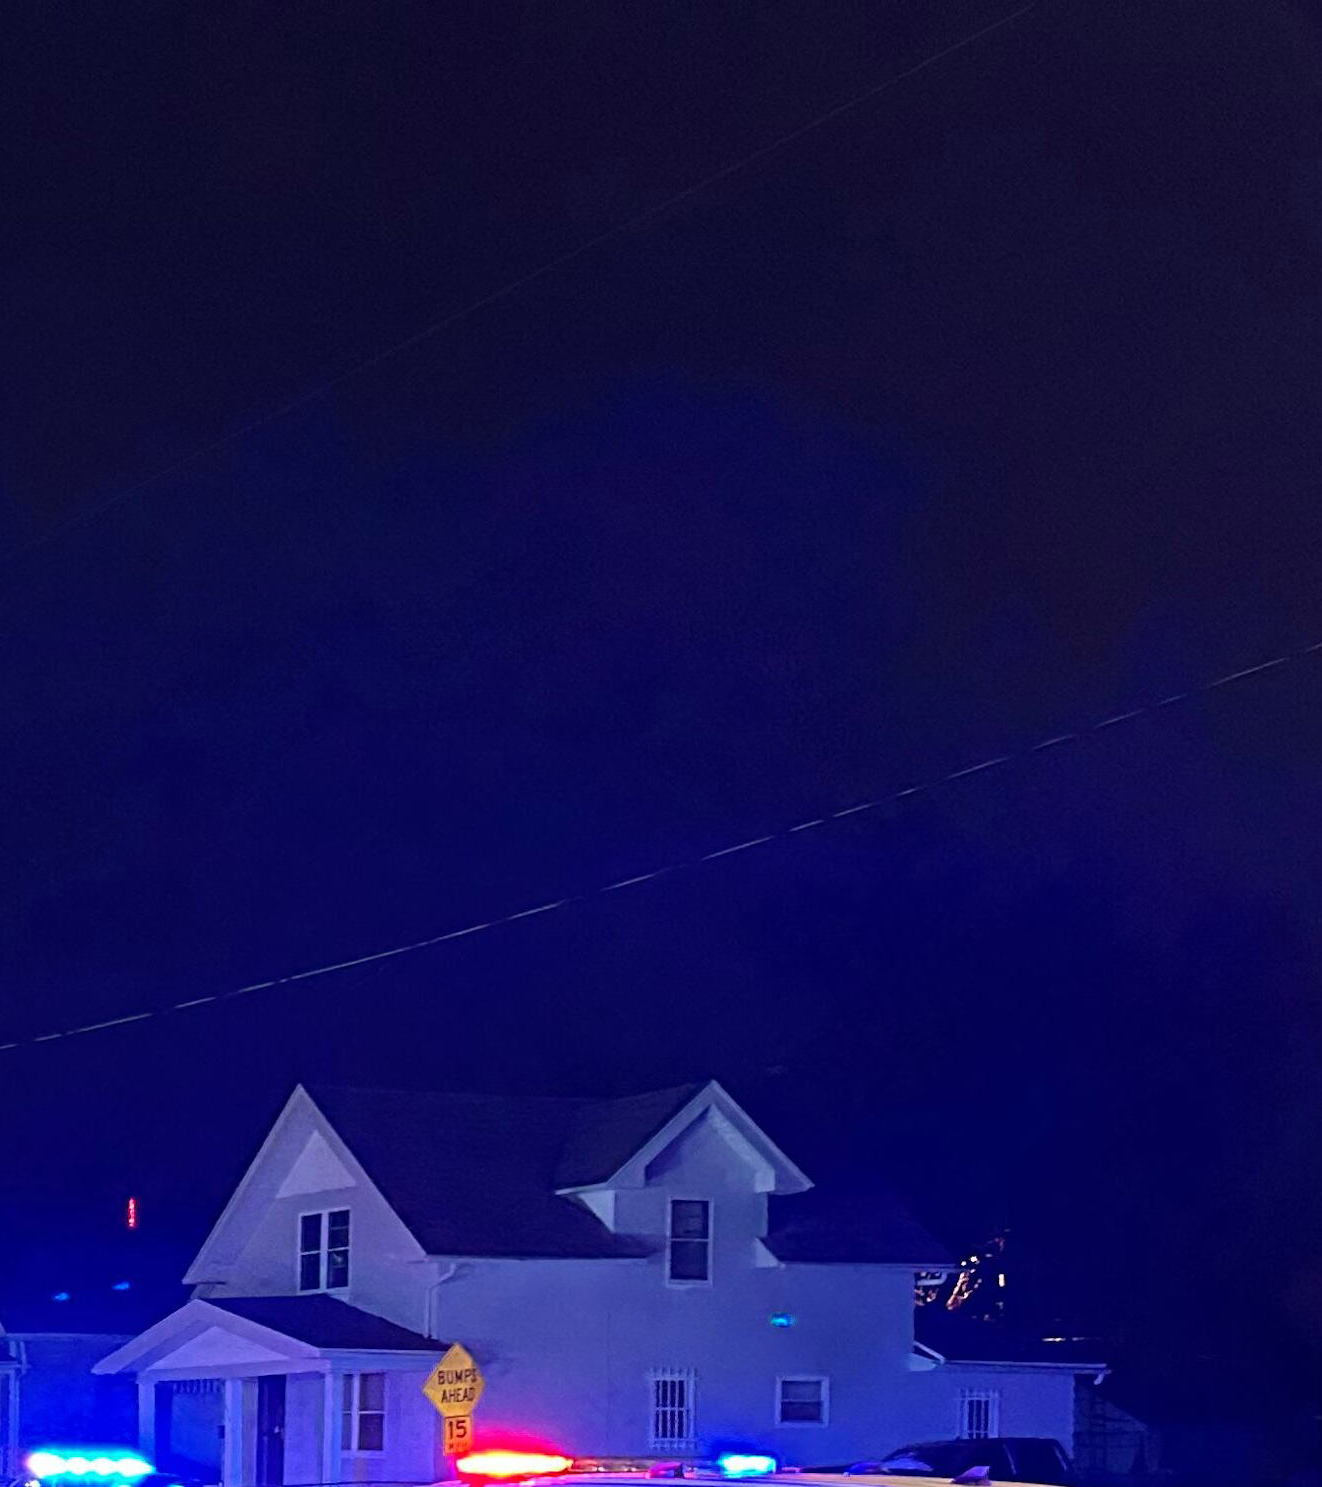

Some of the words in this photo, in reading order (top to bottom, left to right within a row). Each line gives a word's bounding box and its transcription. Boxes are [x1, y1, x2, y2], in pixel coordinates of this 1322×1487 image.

[438, 1368, 477, 1385] BUMPS
[441, 1387, 475, 1403] AHEAD
[449, 1420, 467, 1440] 15
